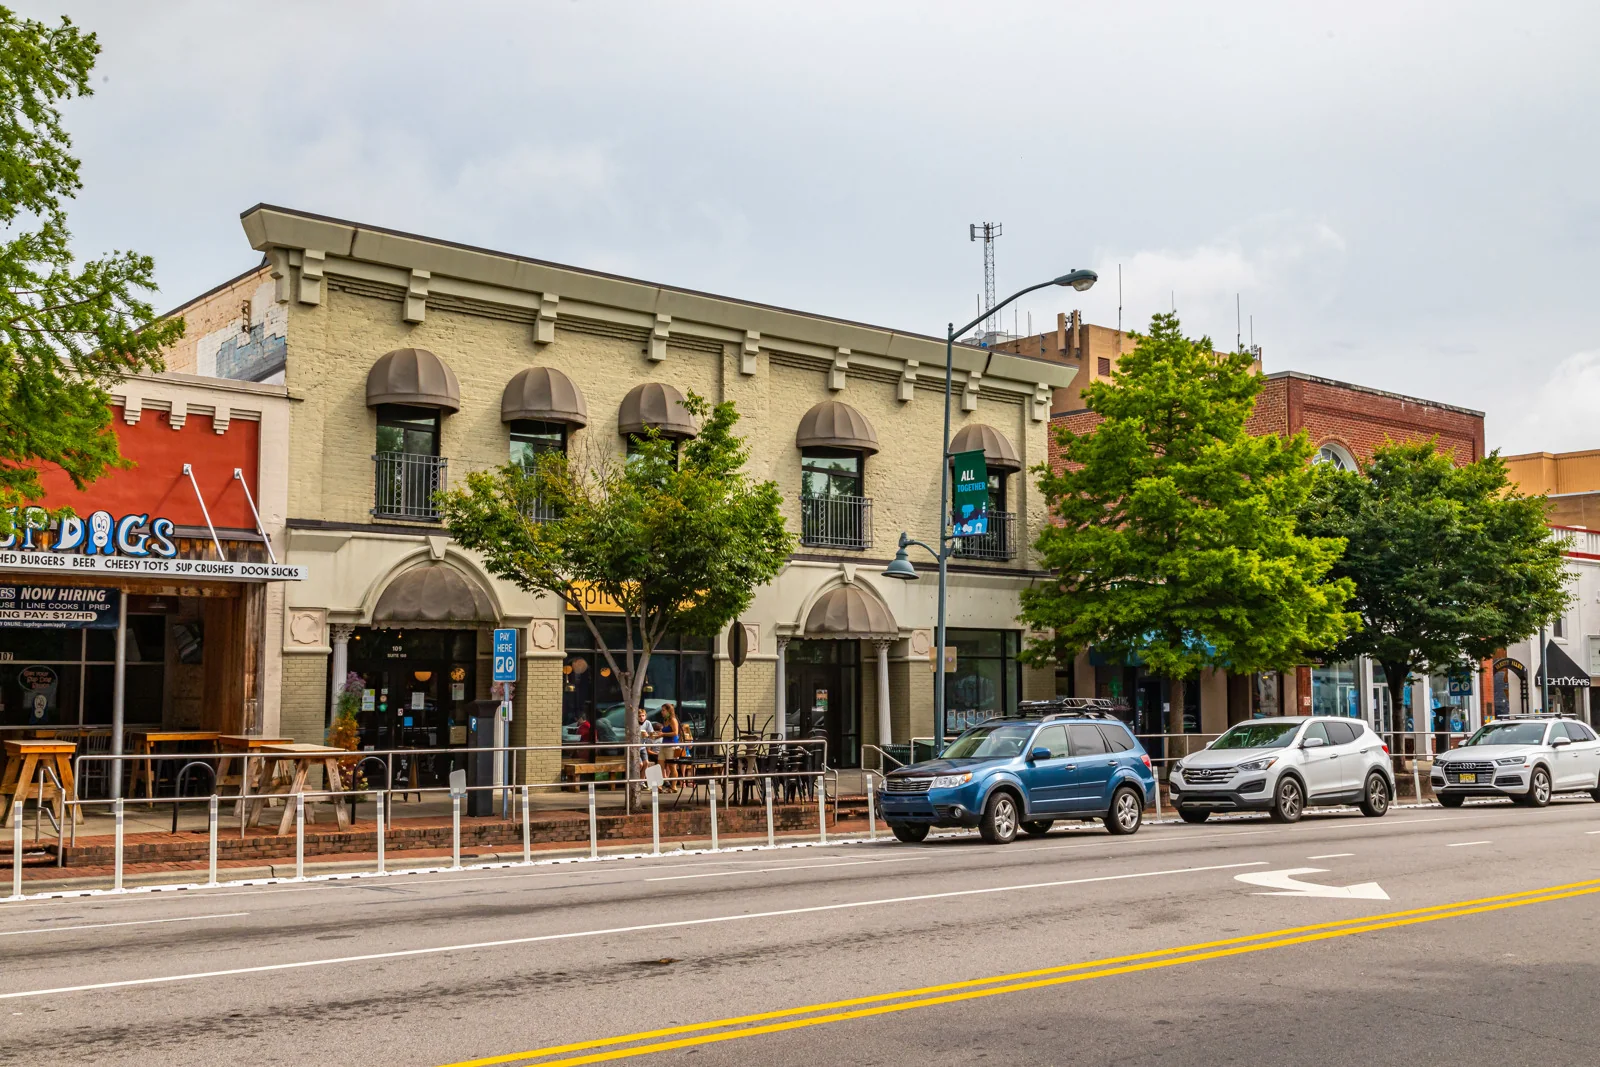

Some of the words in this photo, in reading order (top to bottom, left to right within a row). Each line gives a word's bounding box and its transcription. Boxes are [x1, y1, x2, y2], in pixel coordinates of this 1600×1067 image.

[960, 470, 975, 481] ALL
[957, 482, 985, 492] TOGETHER
[20, 555, 65, 566] BURGERS
[72, 557, 96, 568] BEER
[104, 559, 140, 570] CHEESY
[143, 561, 169, 571] TOTS
[175, 562, 192, 572] SUP
[195, 563, 234, 574] CRUSHES
[241, 565, 269, 576] DOOK
[271, 567, 299, 577] SUCKS
[21, 587, 56, 600] NOW
[58, 589, 106, 602] HIRING
[52, 612, 93, 620] $12/HR
[500, 632, 510, 641] PAY
[497, 643, 513, 653] HERE
